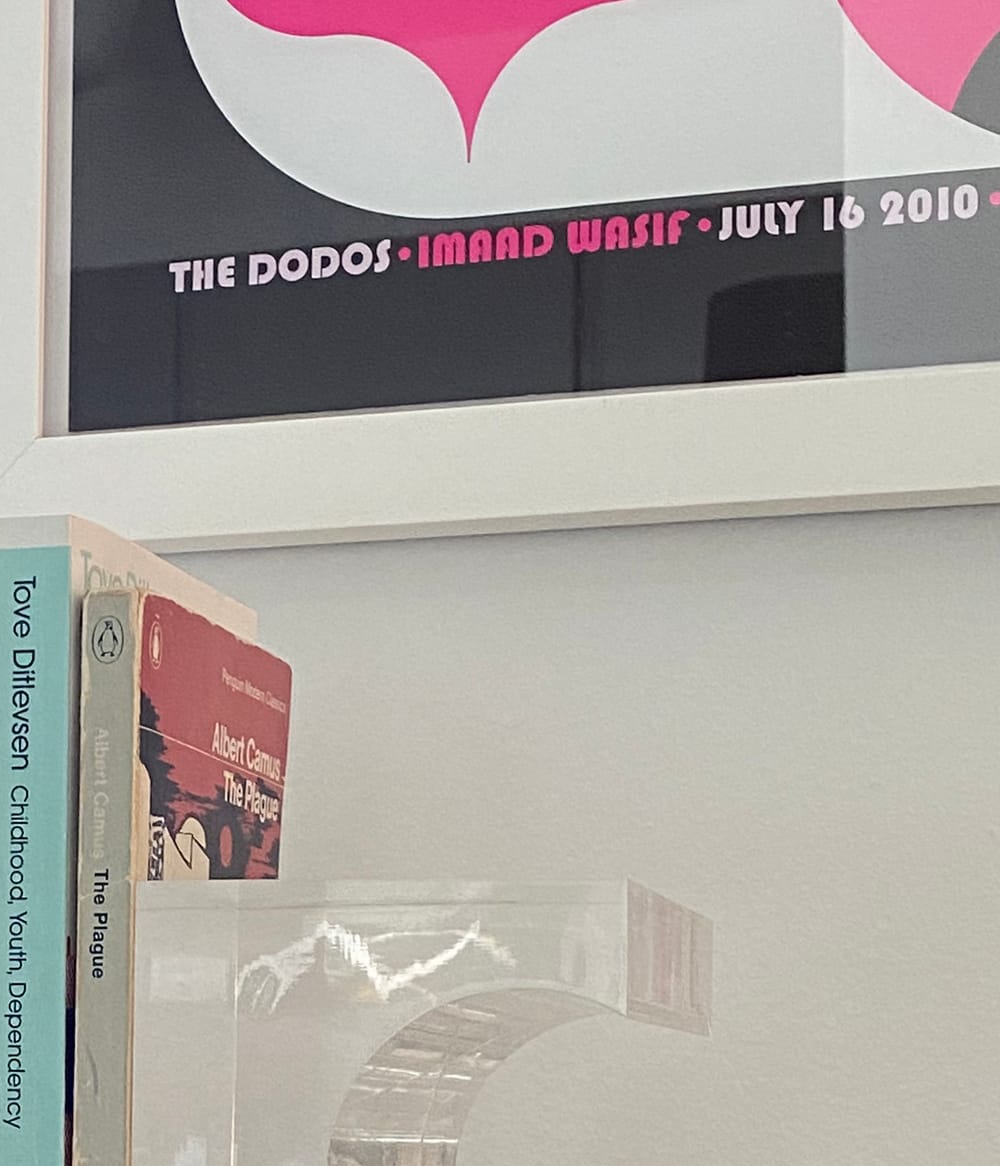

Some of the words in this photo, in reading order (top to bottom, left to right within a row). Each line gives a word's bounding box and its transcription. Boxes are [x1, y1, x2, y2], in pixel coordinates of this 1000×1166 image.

[170, 256, 236, 293] THE
[248, 239, 391, 285] DODOS
[418, 223, 554, 269] IMAAD
[566, 211, 688, 256] WASIF
[719, 200, 806, 241] JULY
[823, 194, 865, 231] 16
[880, 184, 980, 227] 2010
[13, 576, 37, 638] Tove
[11, 649, 36, 770] Ditlevsen
[212, 722, 245, 765] Albert
[246, 738, 281, 782] Camus
[223, 770, 243, 808] The
[244, 779, 279, 823] Plague
[7, 785, 29, 904] Childhood,
[93, 868, 109, 905] The
[6, 911, 28, 975] Youth,
[89, 912, 108, 979] Plague
[3, 983, 27, 1129] Dependency
